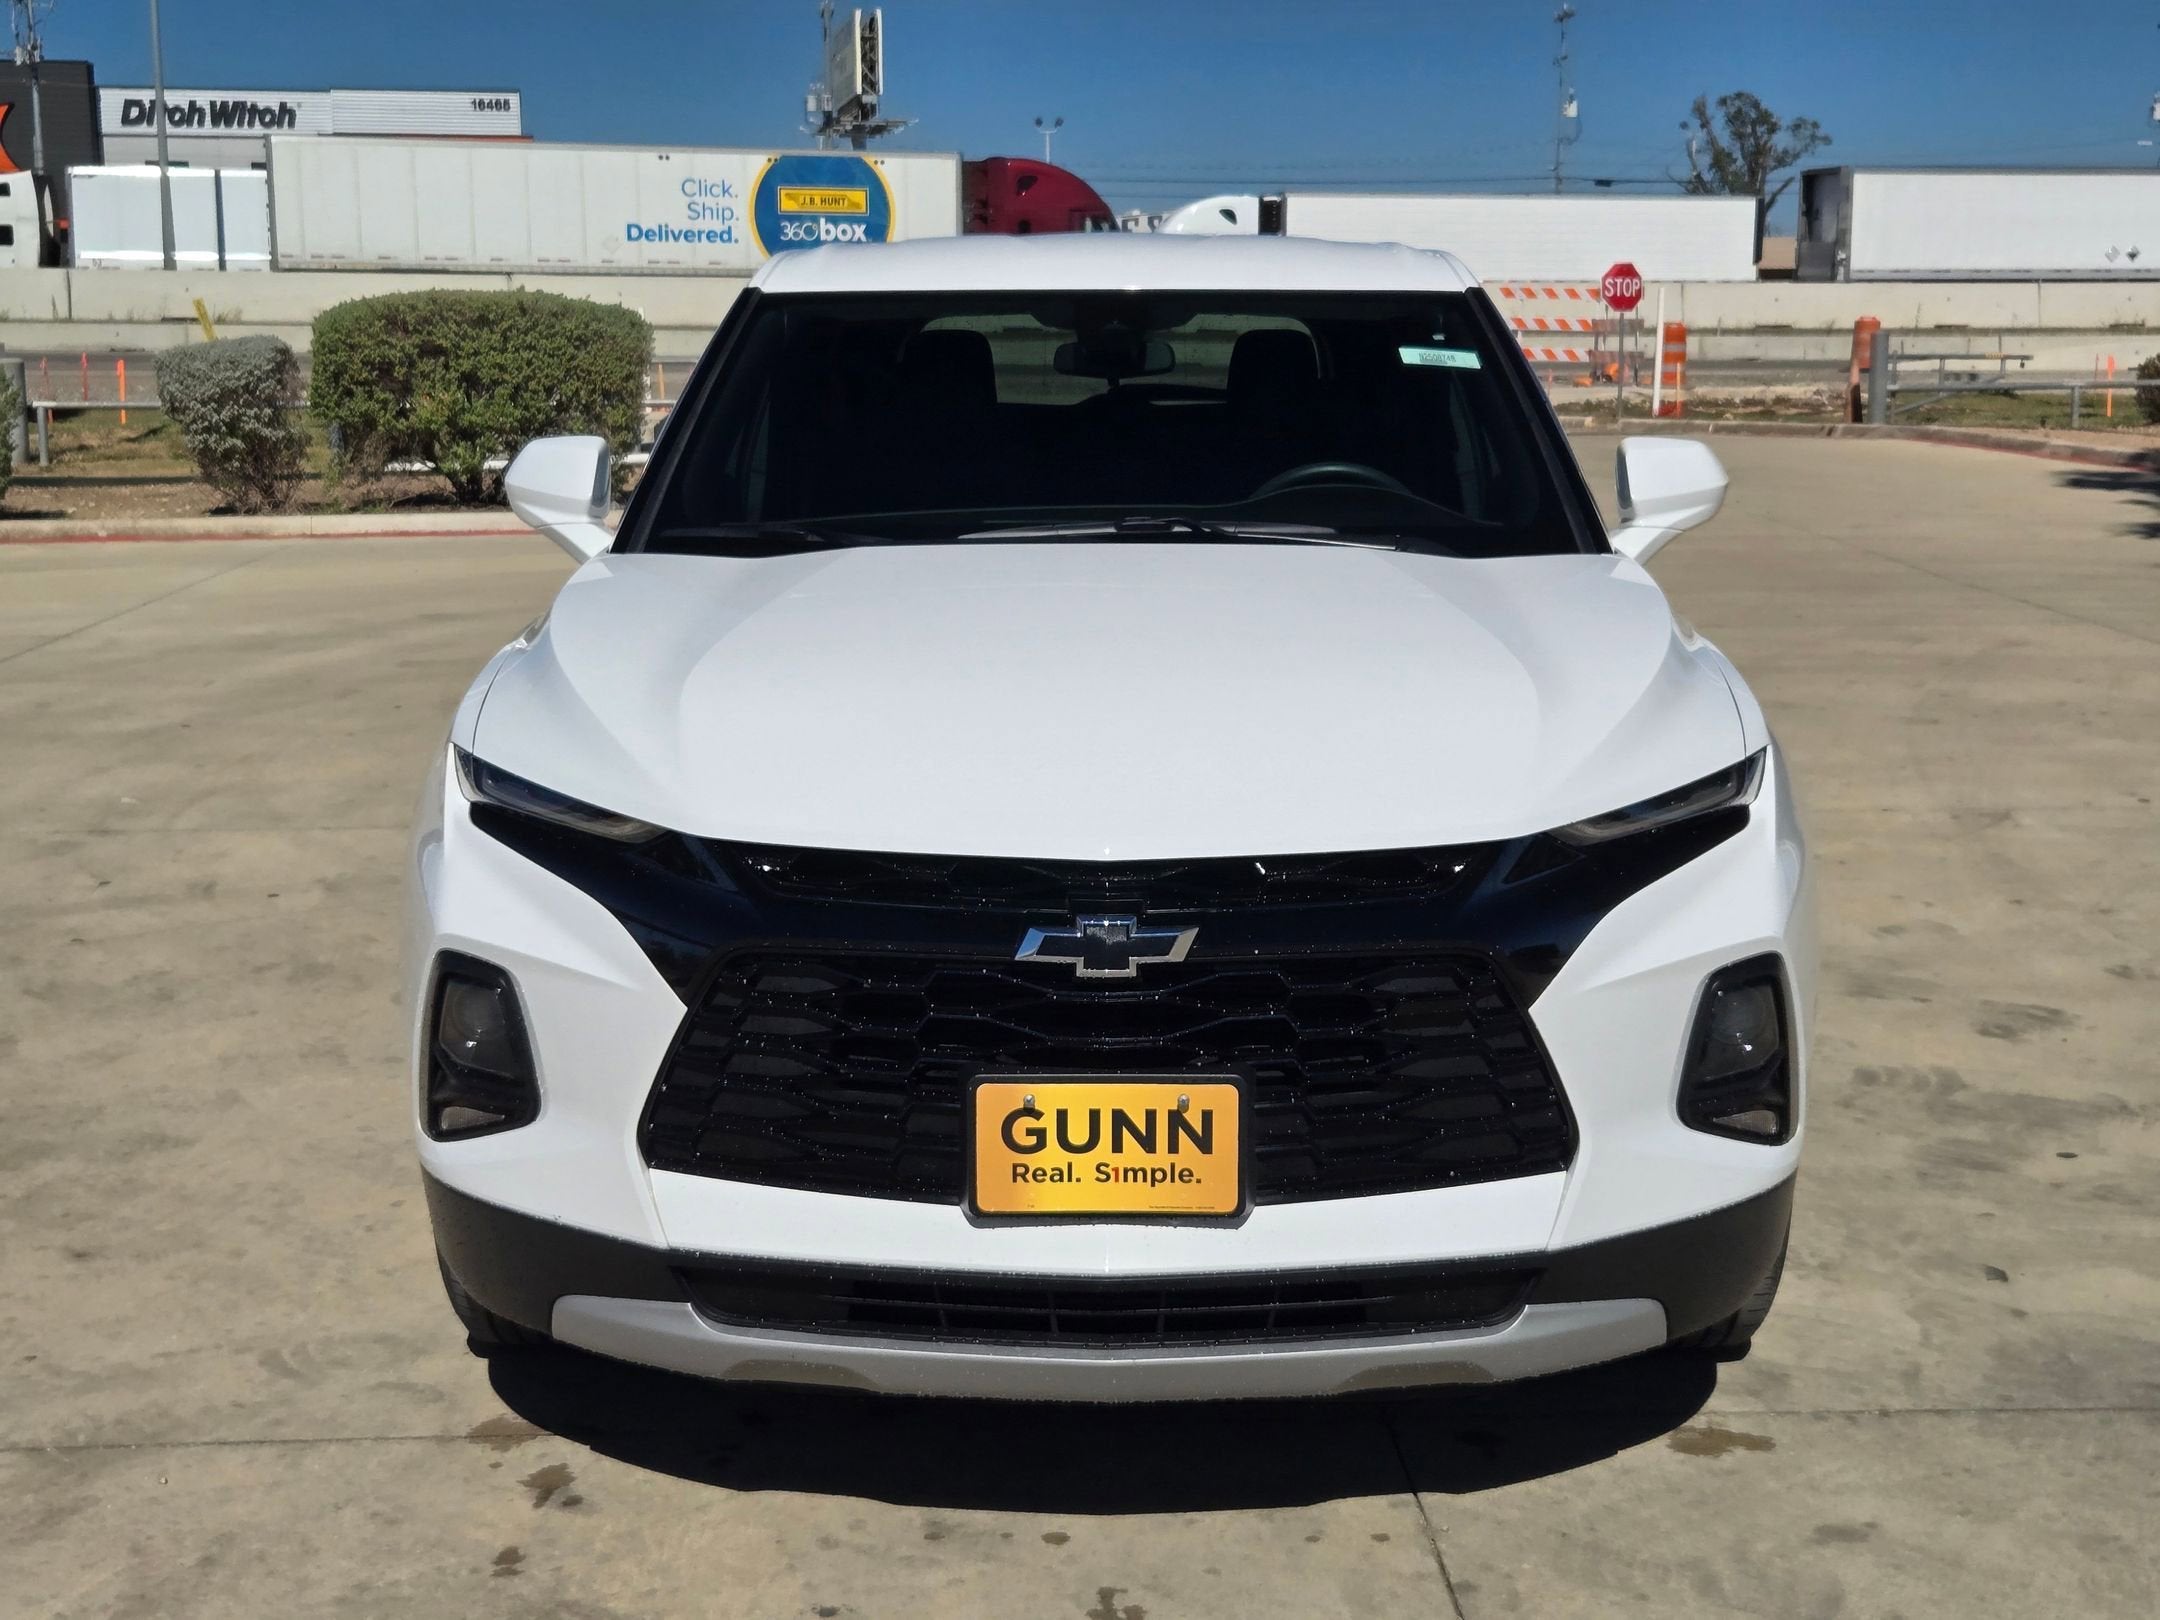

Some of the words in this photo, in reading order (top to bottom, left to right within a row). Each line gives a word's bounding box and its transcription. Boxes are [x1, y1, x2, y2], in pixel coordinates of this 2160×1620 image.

[209, 99, 297, 129] Witch
[681, 178, 739, 199] Click.
[820, 197, 846, 206] HUNT
[687, 202, 739, 226] Ship.
[626, 223, 739, 244] Delivered.
[1604, 278, 1641, 297] STOP
[1001, 1107, 1213, 1154] GUNN
[1011, 1161, 1081, 1184] Real.
